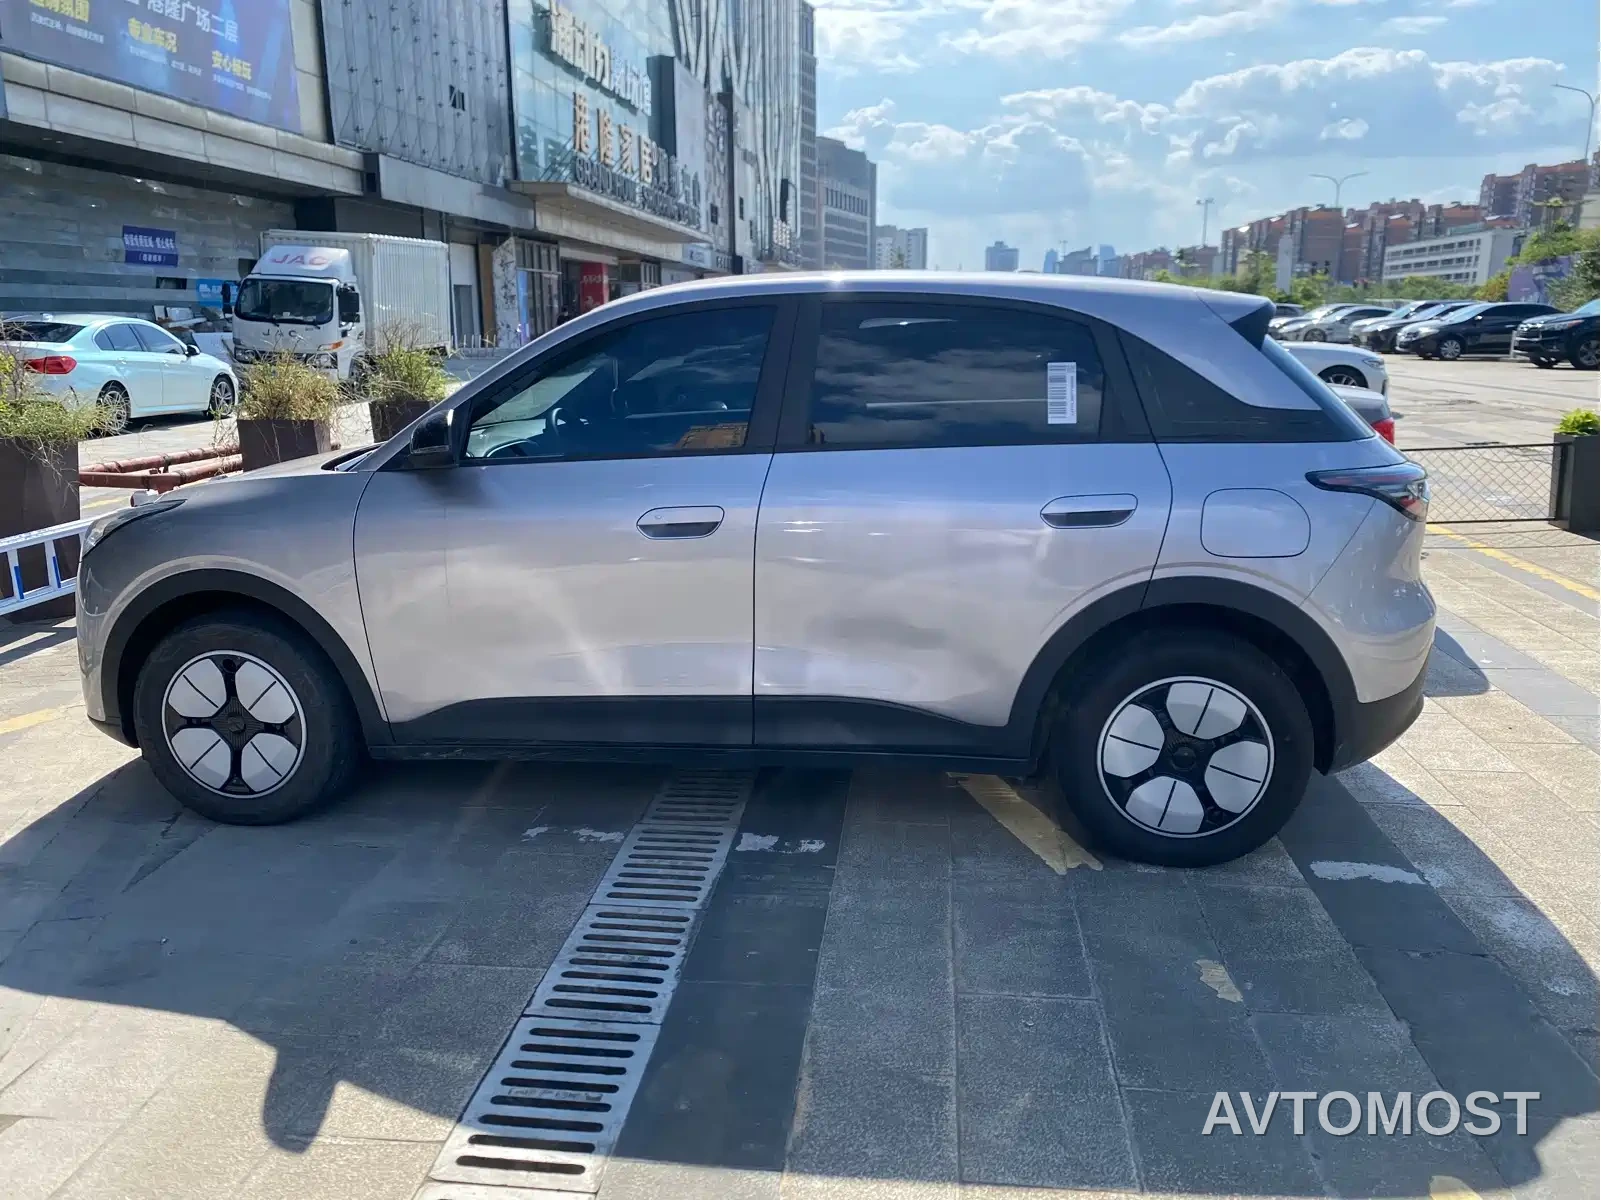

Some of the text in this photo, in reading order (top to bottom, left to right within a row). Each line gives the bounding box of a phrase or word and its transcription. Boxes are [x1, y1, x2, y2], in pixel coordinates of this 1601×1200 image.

[574, 90, 652, 184] 港隆家居
[271, 254, 328, 266] JAC
[262, 328, 297, 338] JAC
